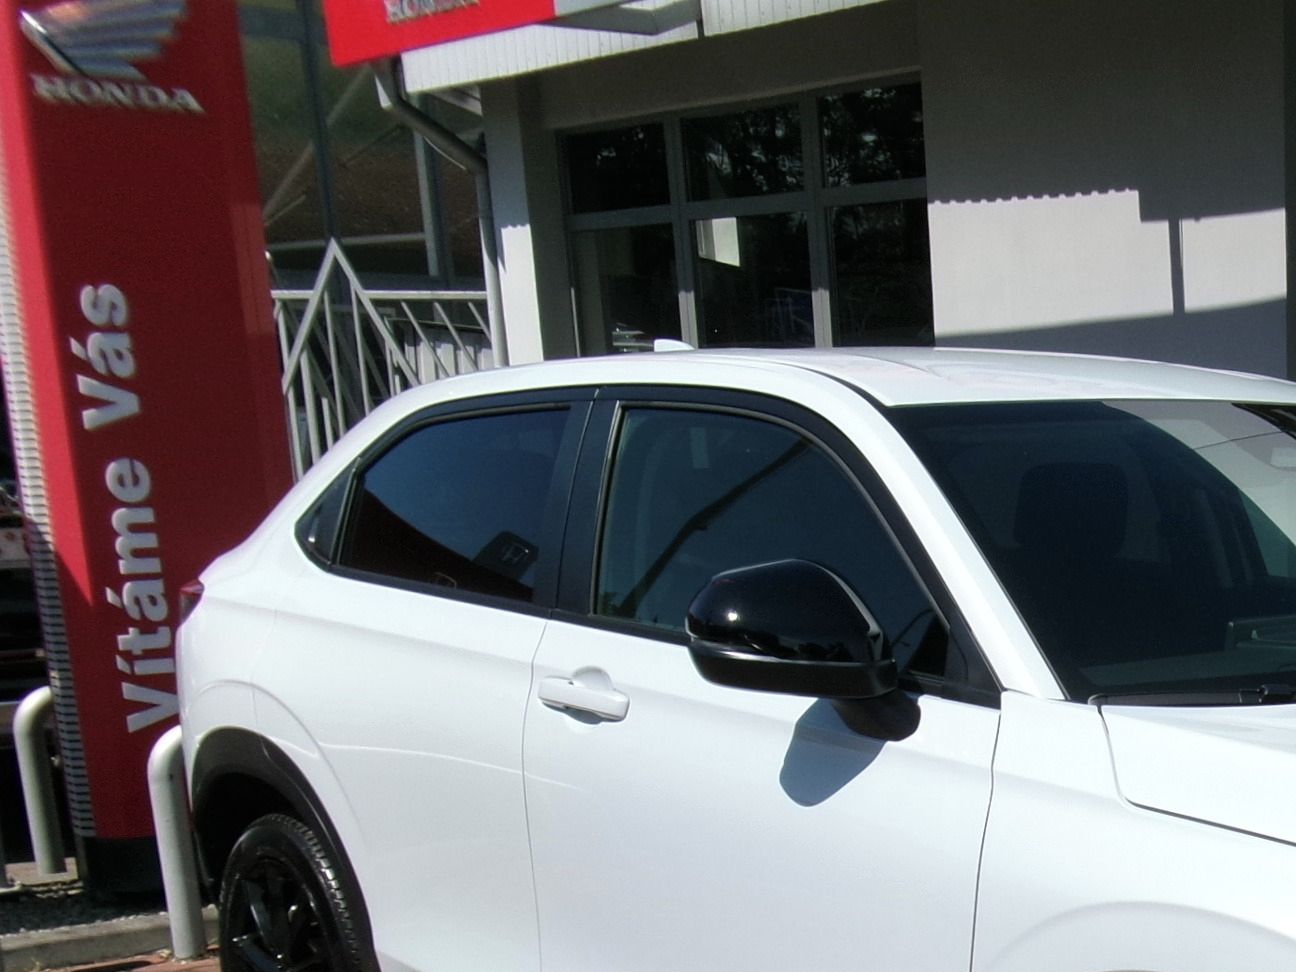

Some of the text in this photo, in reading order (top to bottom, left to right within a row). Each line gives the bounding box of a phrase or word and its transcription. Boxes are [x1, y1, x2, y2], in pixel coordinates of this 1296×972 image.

[30, 73, 206, 114] HONDA
[68, 282, 180, 733] Vítáme Vás
